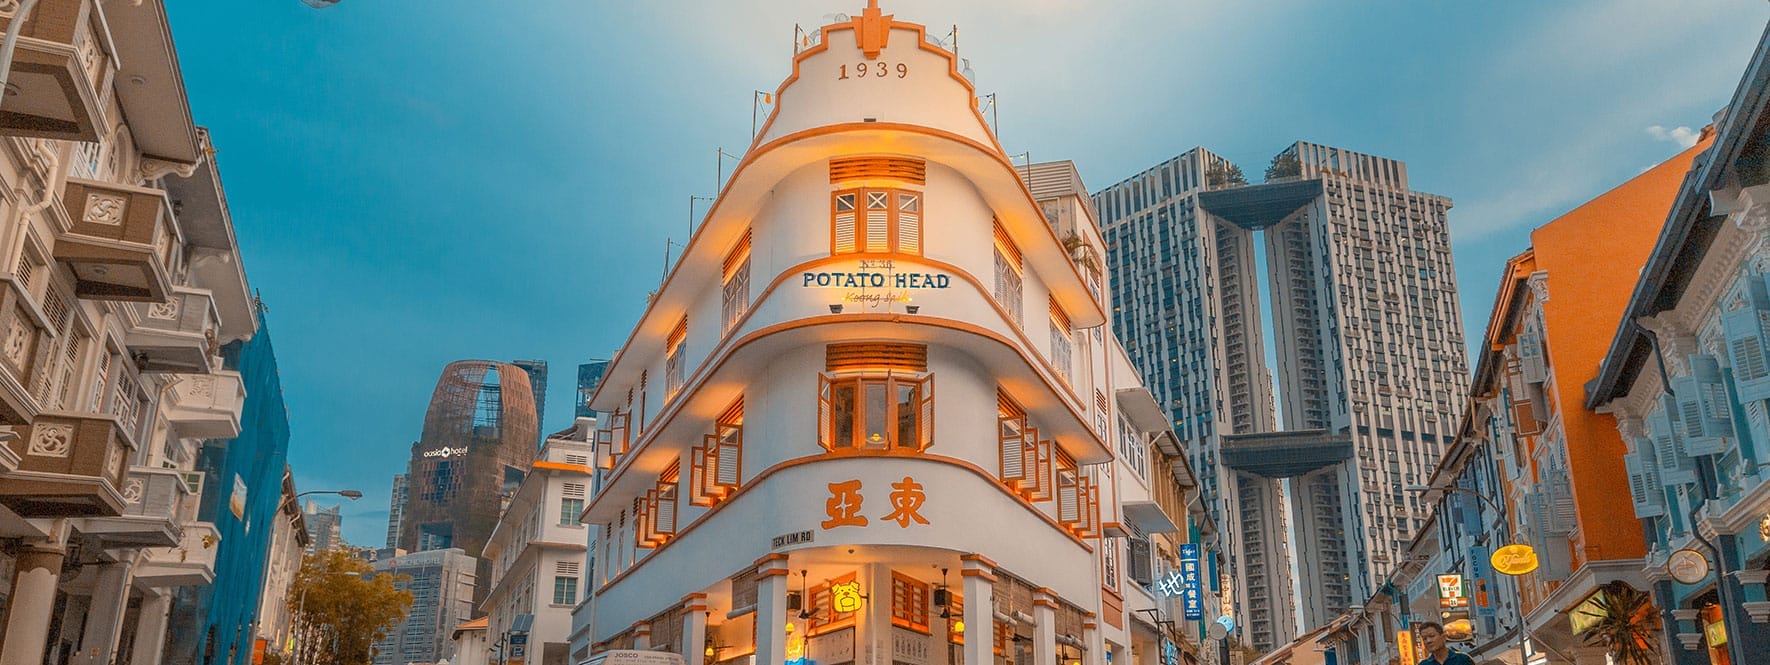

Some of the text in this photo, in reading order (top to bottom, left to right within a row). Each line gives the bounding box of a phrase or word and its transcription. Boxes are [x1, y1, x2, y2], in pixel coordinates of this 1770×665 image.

[838, 61, 908, 81] 1939
[803, 272, 950, 289] POTATO HEAD
[773, 530, 811, 548] TECK LIM RD
